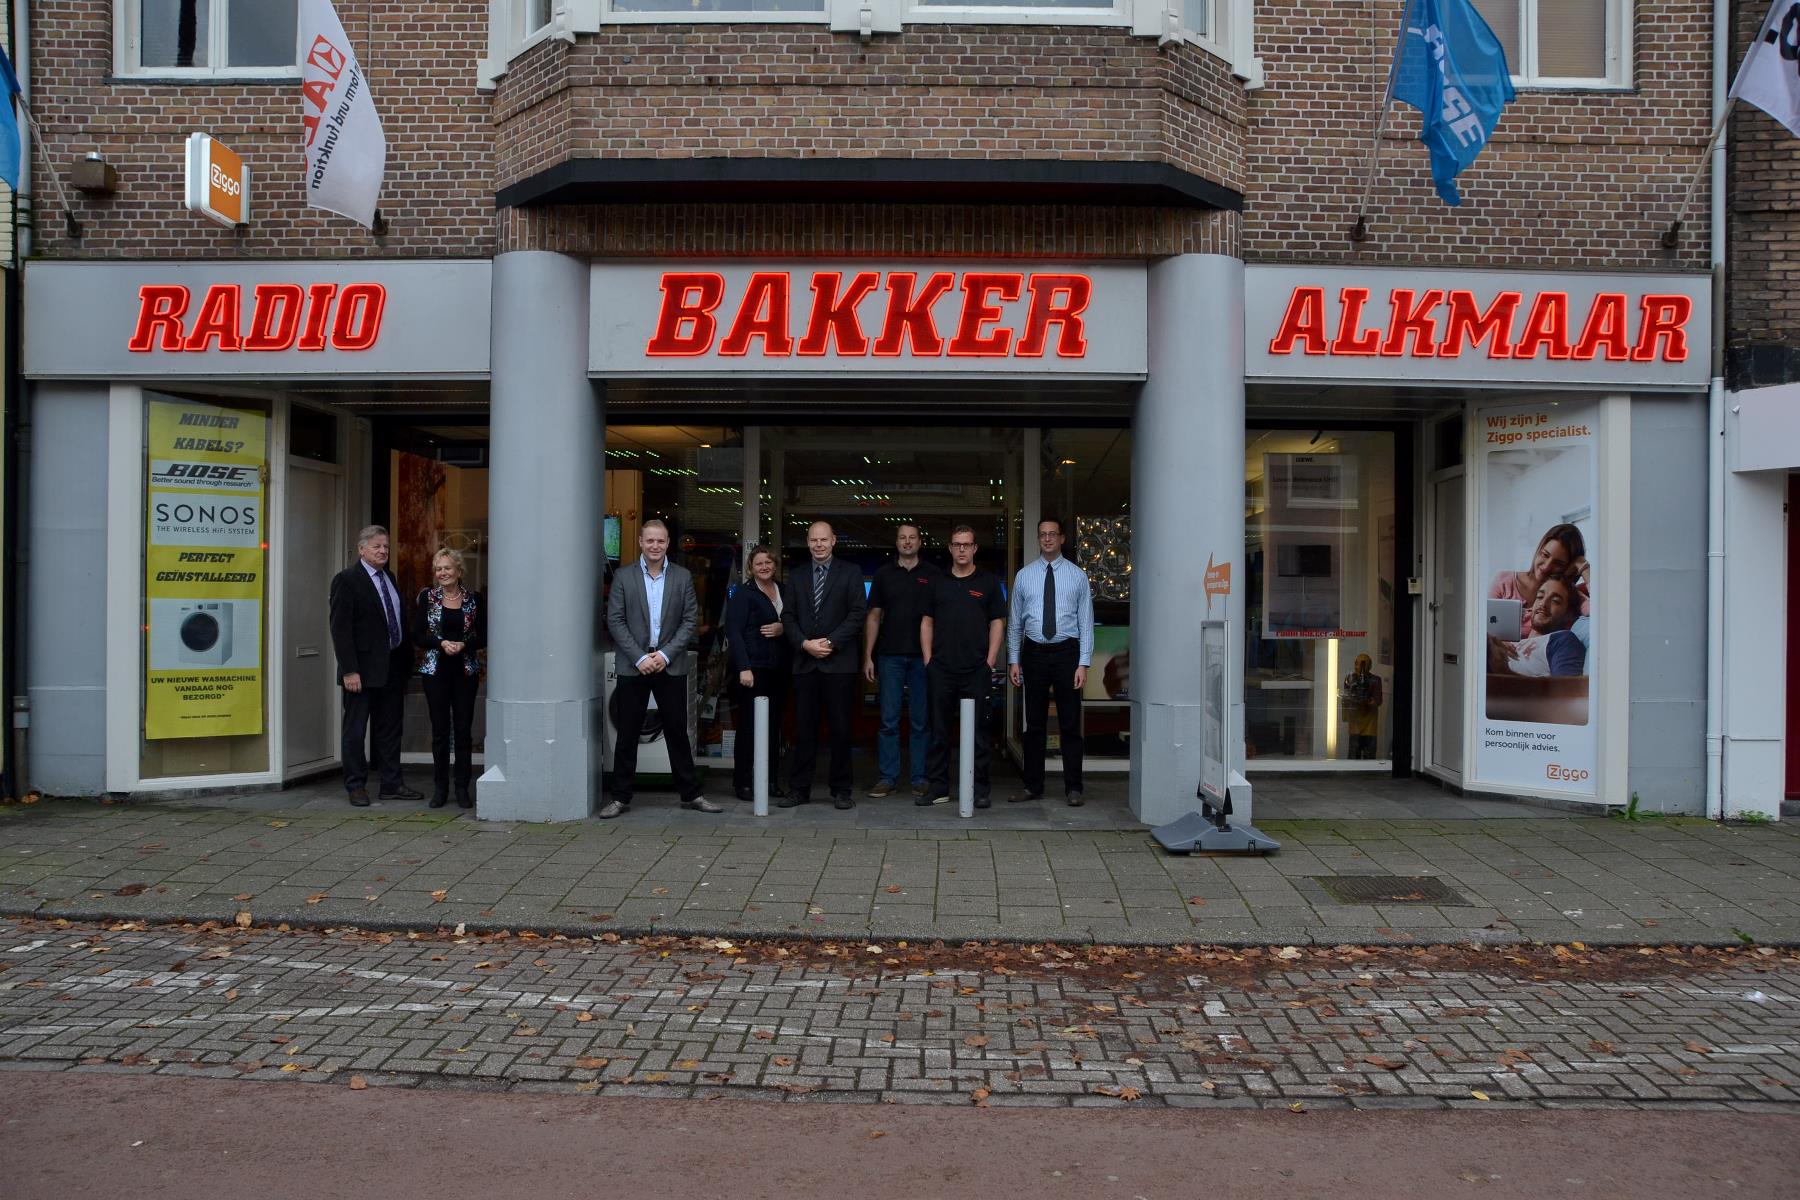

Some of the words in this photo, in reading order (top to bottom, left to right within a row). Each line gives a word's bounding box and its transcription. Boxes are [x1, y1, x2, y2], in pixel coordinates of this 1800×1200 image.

[127, 281, 387, 352] RADIO
[645, 271, 1093, 358] BAKKER
[1269, 285, 1693, 362] ALKMAAR
[179, 412, 240, 430] MINDER
[1486, 415, 1507, 429] Wij
[1510, 413, 1533, 428] zijn
[1535, 412, 1548, 426] je
[1487, 431, 1523, 444] Ziggo
[1526, 424, 1592, 442] specialist.
[173, 437, 245, 454] KABELS?
[152, 463, 258, 481] BOSE
[174, 477, 196, 485] sound
[196, 478, 223, 487] through
[156, 503, 256, 526] SONOS
[179, 552, 236, 564] PERFECT
[166, 676, 200, 684] NIEUWE
[202, 675, 257, 683] WASMACHINE
[1485, 728, 1504, 736] Kom
[1505, 729, 1535, 739] binnen
[1536, 732, 1557, 741] voor
[1485, 740, 1530, 752] persoonlijk
[1531, 742, 1560, 753] advies.
[1546, 763, 1589, 781] Ziggo
